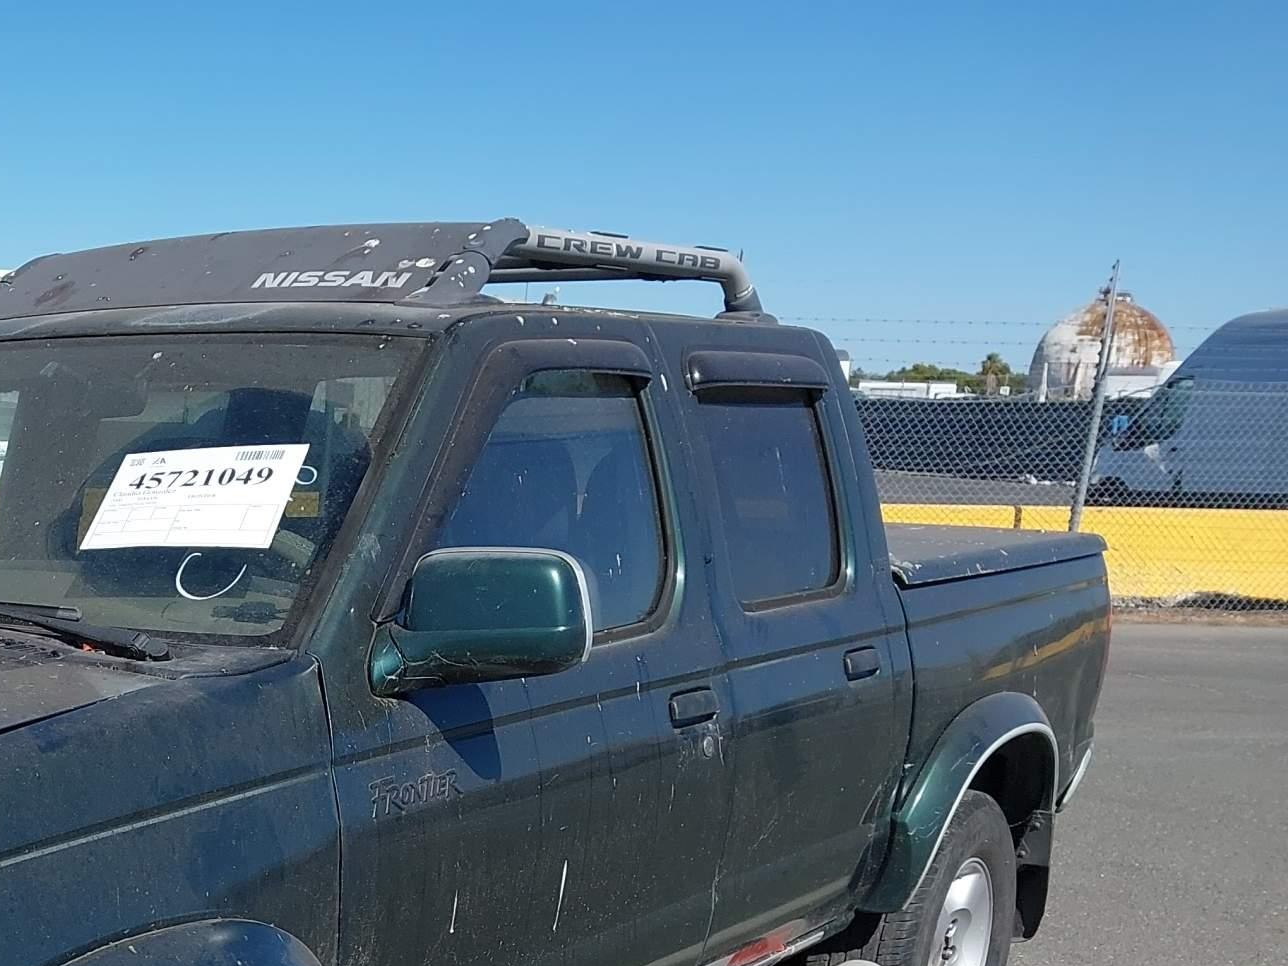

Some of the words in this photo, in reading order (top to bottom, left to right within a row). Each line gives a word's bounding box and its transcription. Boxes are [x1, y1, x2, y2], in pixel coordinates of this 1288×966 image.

[537, 234, 643, 260] CREW
[656, 249, 721, 270] CAB
[250, 270, 412, 289] NISSAN
[128, 466, 275, 490] 45721049
[368, 768, 464, 819] FRONTIER
